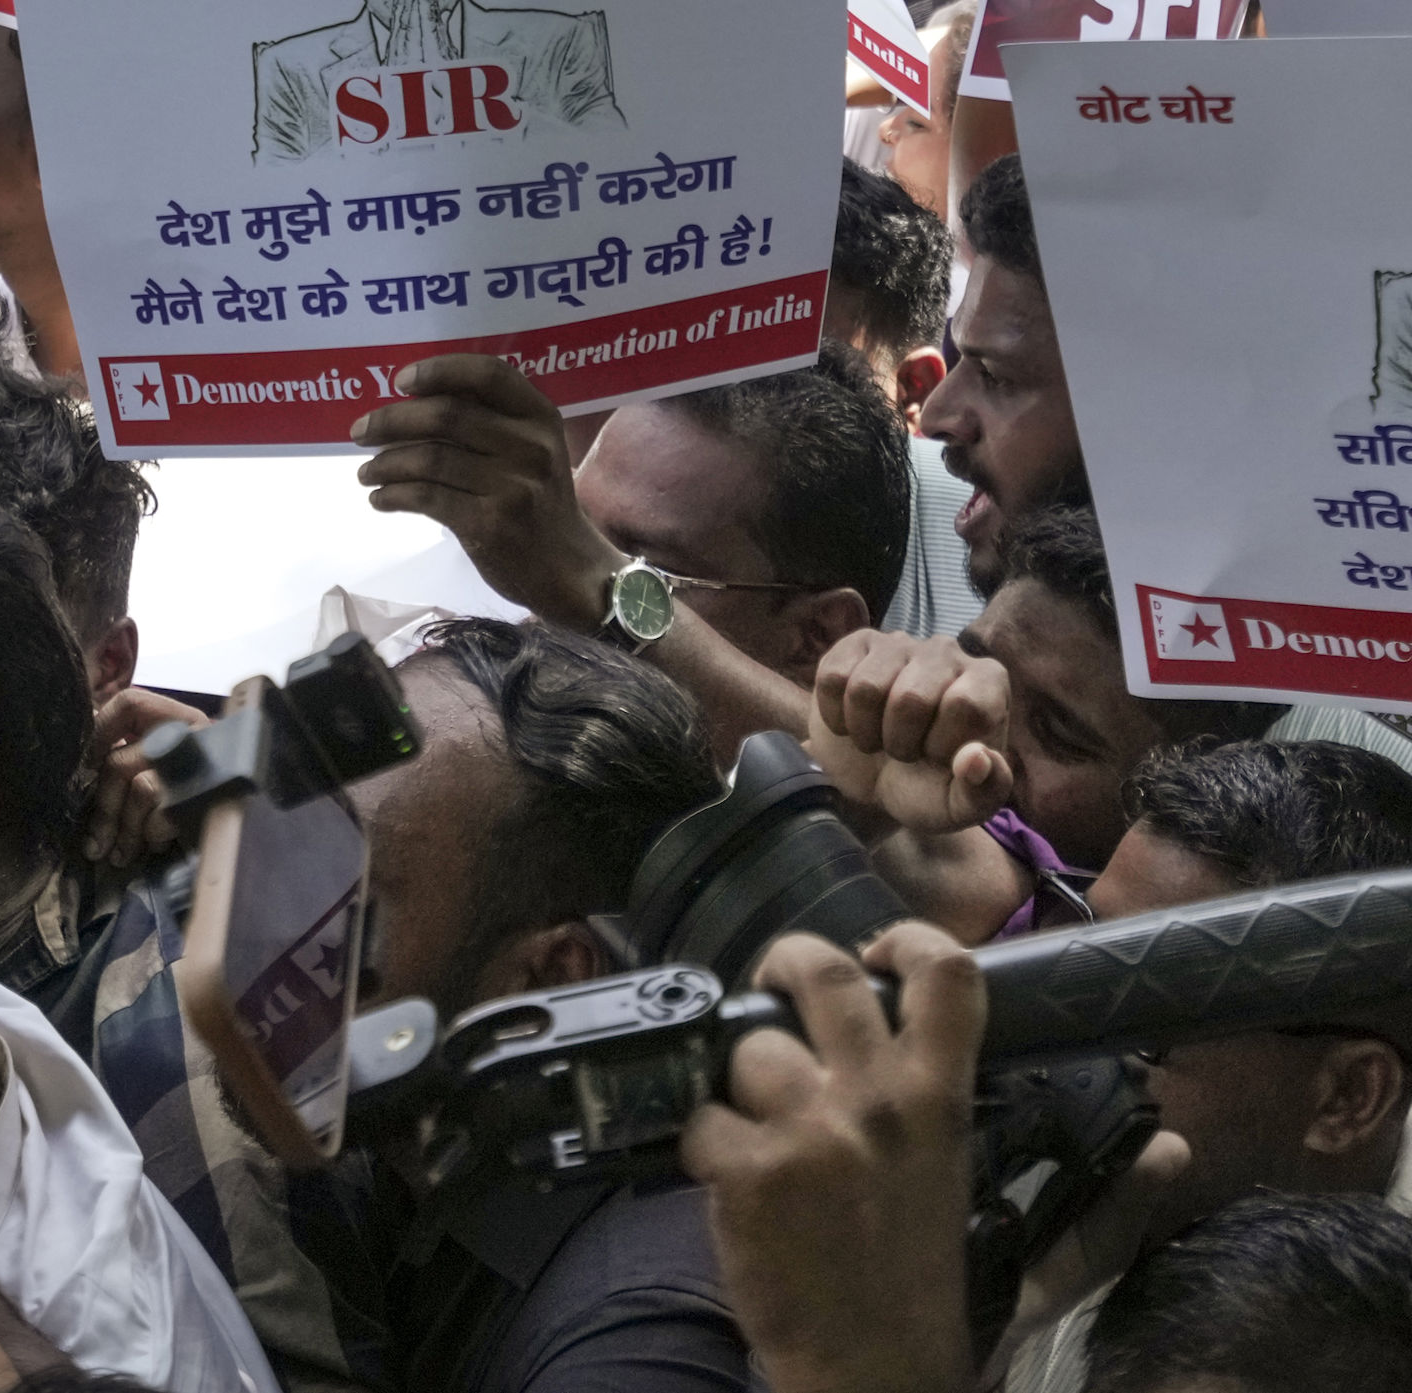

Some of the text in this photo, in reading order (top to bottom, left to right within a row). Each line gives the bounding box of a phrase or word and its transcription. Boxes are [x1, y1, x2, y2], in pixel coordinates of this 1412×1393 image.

[850, 22, 922, 85] India
[333, 63, 524, 148] SIR
[1075, 84, 1236, 125] वोट चोर
[155, 151, 738, 263] देश मुझे माफ़ नहीं करेगा
[131, 277, 203, 326] मैने
[212, 275, 288, 323] देश
[297, 267, 350, 318] के
[362, 270, 471, 316] साथ
[643, 223, 710, 277] की
[719, 213, 774, 267] है!
[171, 366, 363, 406] Democratic
[686, 309, 725, 344] of
[725, 293, 814, 335] India
